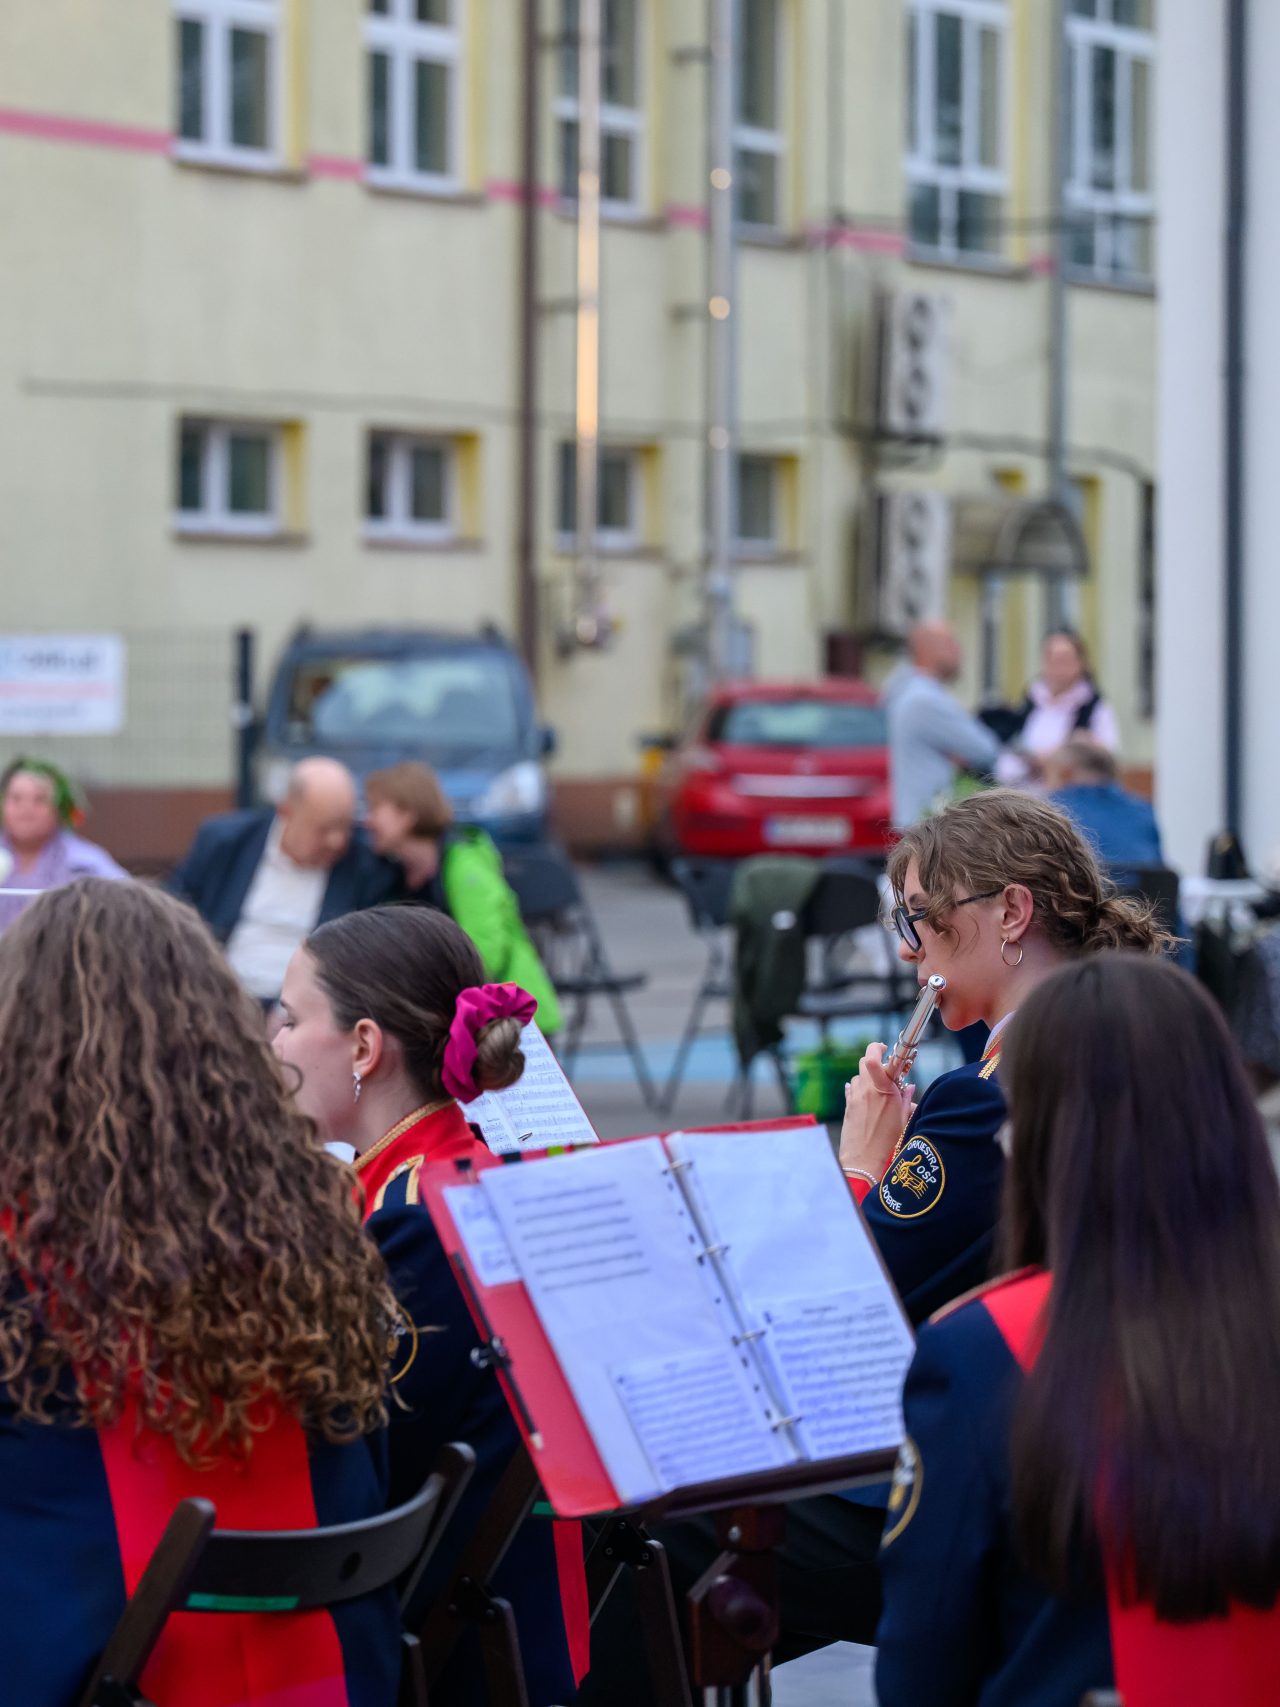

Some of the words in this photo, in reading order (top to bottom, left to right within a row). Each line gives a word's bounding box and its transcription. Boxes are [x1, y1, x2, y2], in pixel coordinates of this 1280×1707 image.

[907, 1140, 939, 1173] ORKIESTRA
[916, 1165, 937, 1184] OSP
[882, 1184, 902, 1211] DOBRE
